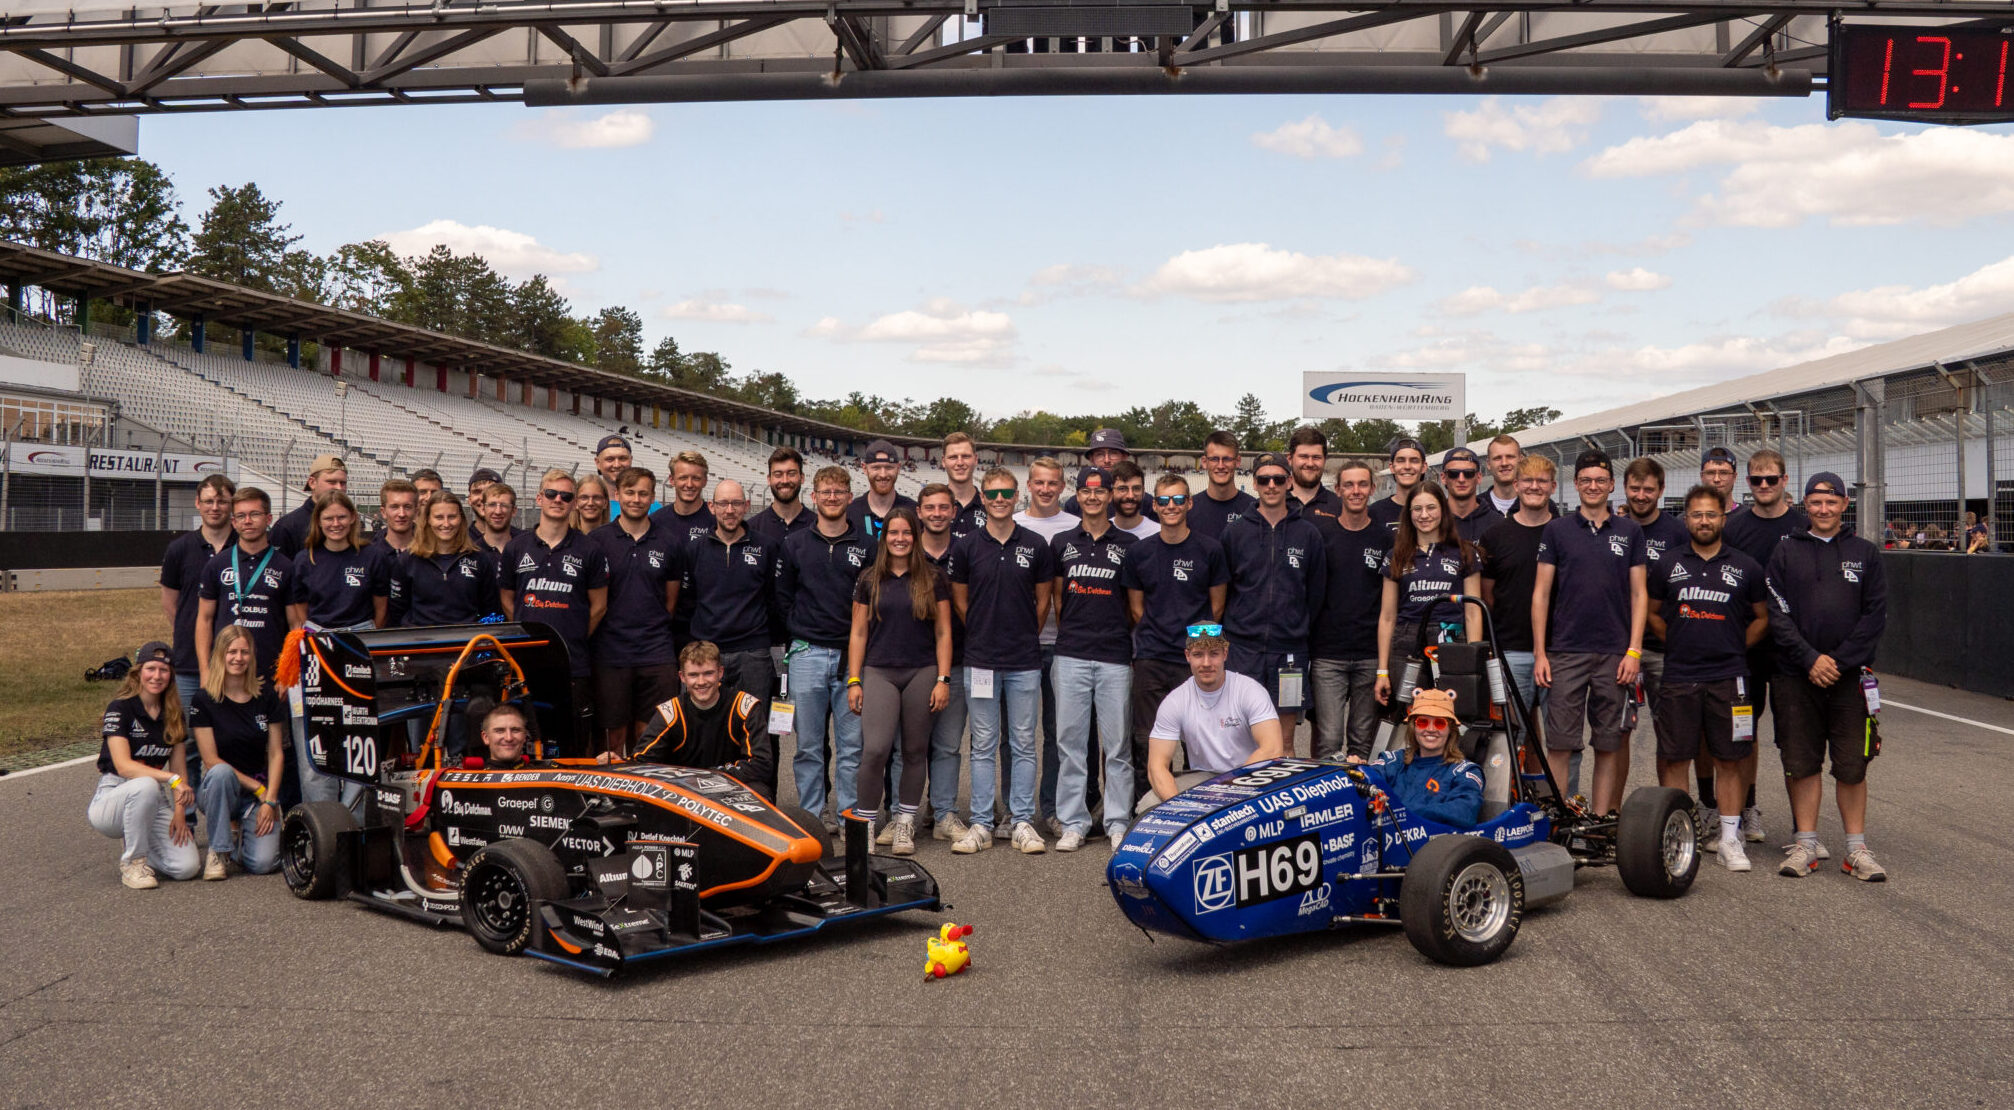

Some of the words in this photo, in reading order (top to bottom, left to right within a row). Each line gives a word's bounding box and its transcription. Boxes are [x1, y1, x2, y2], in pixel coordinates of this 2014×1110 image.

[1068, 564, 1116, 579] Altium
[526, 577, 573, 593] Altium
[1408, 580, 1452, 592] Altium
[1678, 586, 1730, 603] Altium
[342, 734, 377, 777] 120
[444, 772, 493, 782] TESLA
[513, 773, 541, 782] BENDER
[553, 772, 576, 782] Ansys
[575, 773, 599, 789] UAS
[599, 777, 665, 799] DIEPHOLZ
[1258, 791, 1294, 814] UAS
[1291, 774, 1353, 802] Diepholz
[497, 796, 537, 811] Graepel
[677, 796, 733, 827] POLYTEC
[1210, 804, 1256, 831] stanitech
[1300, 803, 1354, 828] IRMLER
[640, 832, 658, 842] Detlef
[1259, 819, 1285, 840] MLP
[562, 836, 601, 852] VECTOR
[1329, 832, 1355, 852] BASF
[681, 849, 695, 858] MLP
[1238, 840, 1319, 901] H69
[573, 915, 604, 932] WestWind
